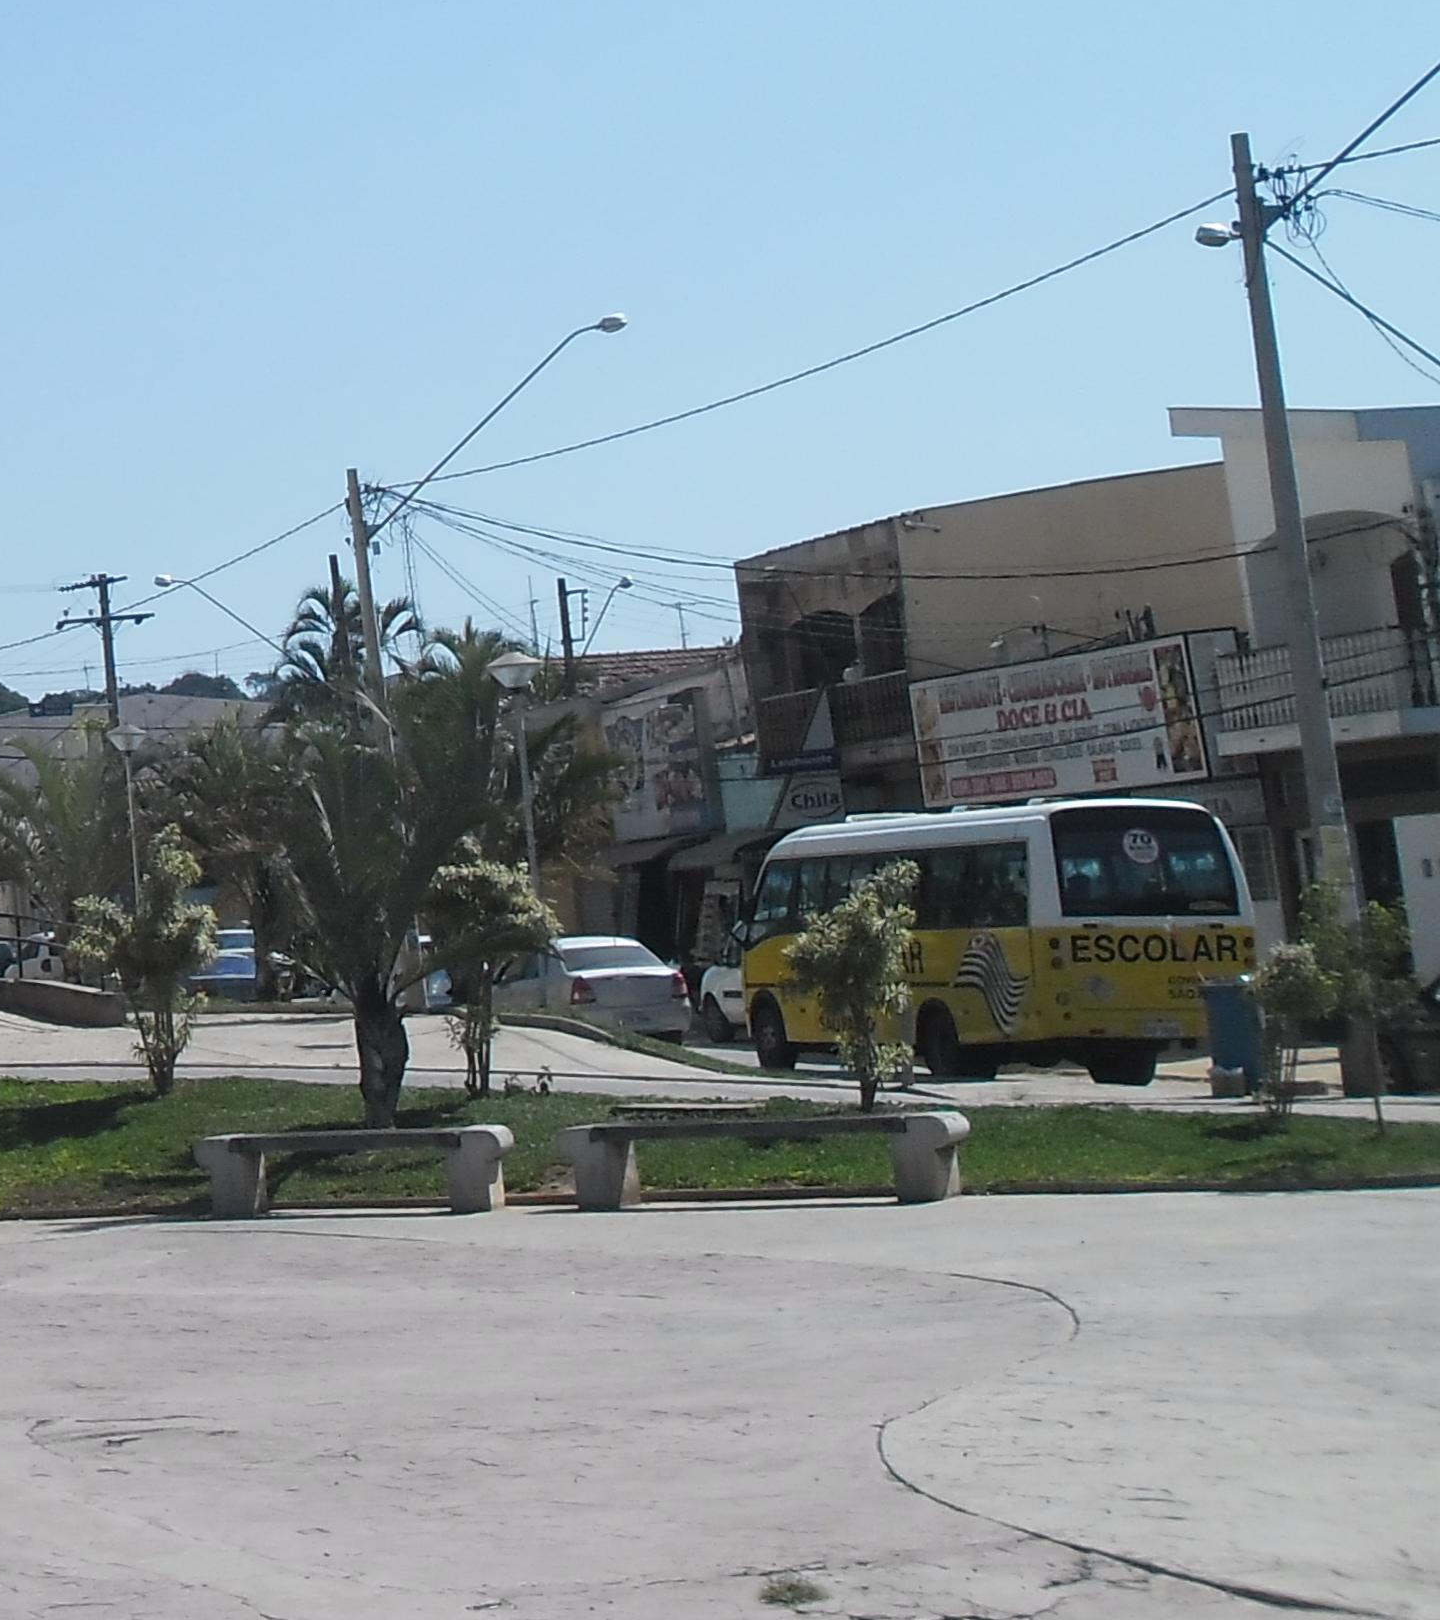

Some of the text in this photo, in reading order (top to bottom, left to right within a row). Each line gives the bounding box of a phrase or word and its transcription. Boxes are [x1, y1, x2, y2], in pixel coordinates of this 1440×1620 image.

[996, 704, 1040, 730] DOCE
[1062, 697, 1093, 722] CIA
[1128, 833, 1153, 845] 70
[1071, 934, 1238, 963] ESCOLAR
